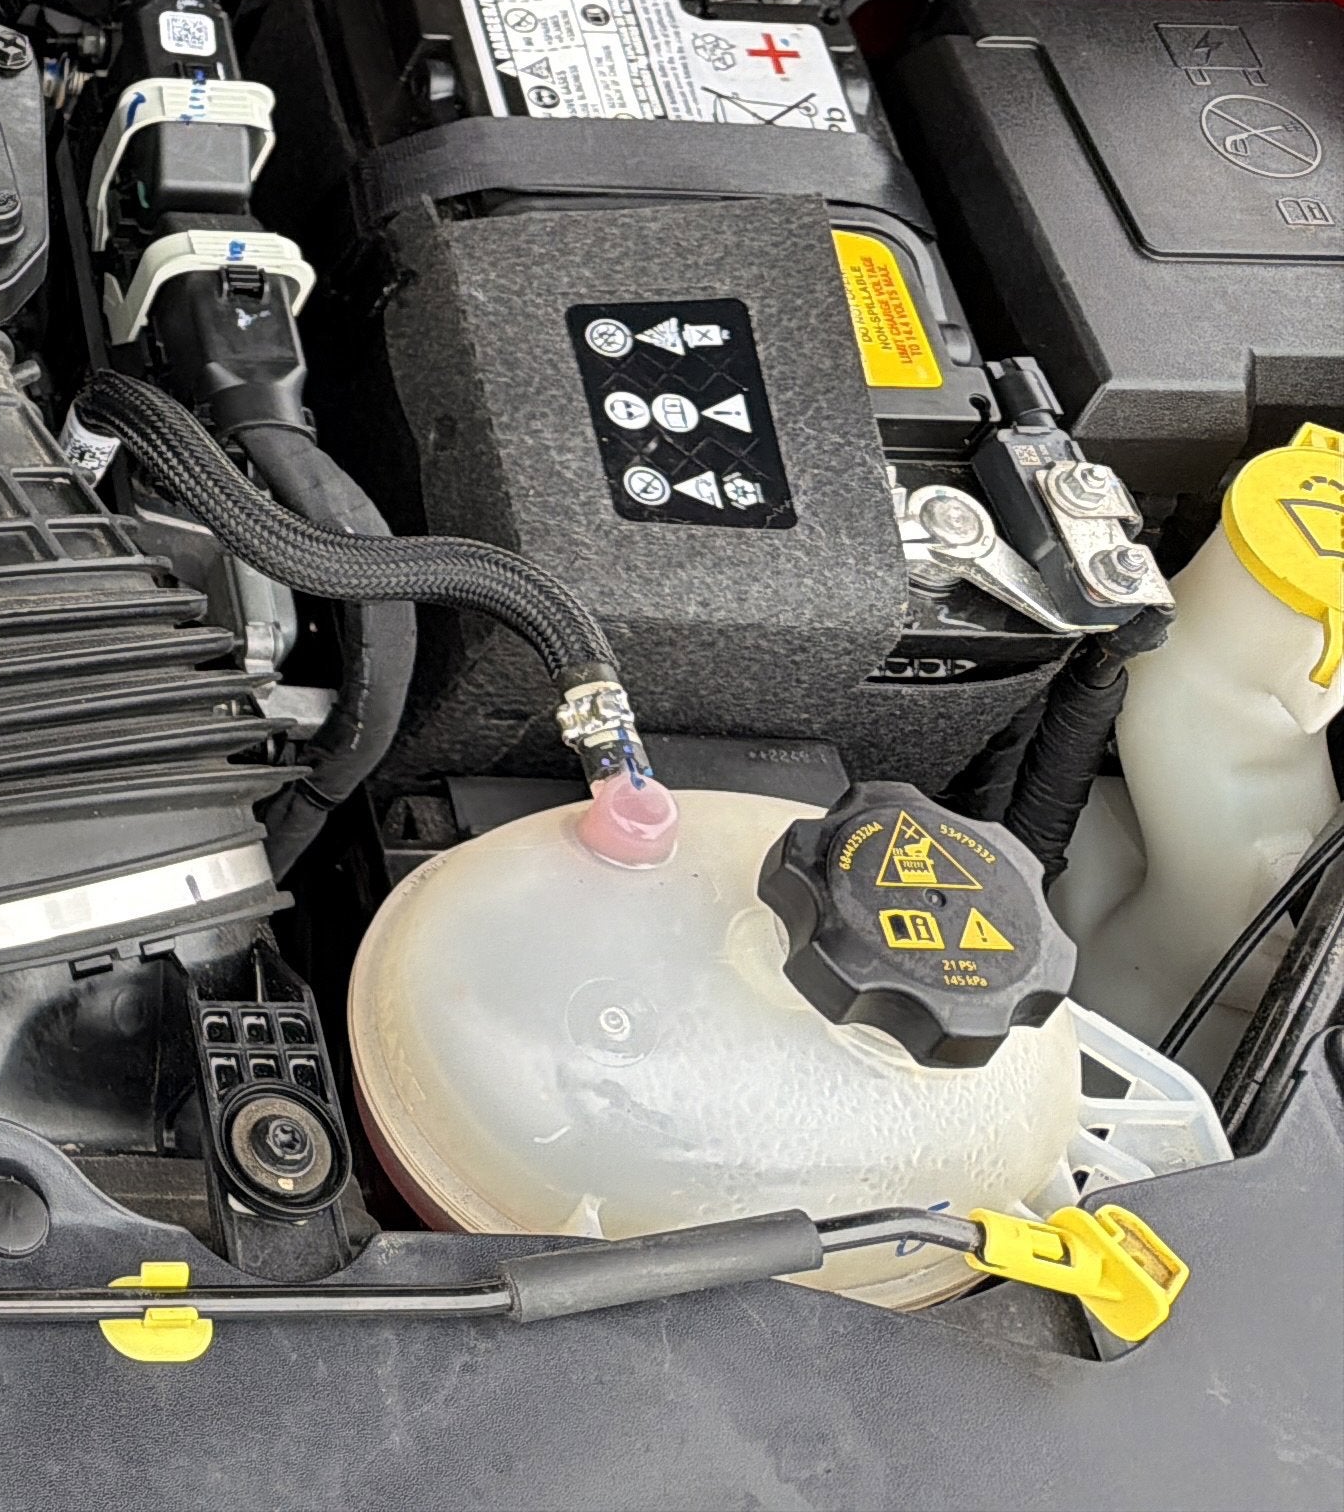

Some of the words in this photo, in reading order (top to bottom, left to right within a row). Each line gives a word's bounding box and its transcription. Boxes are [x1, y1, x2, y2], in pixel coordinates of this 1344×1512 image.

[939, 823, 997, 865] 53479332
[942, 959, 957, 971] 21
[943, 974, 966, 986] 145
[965, 974, 988, 987] kPa
